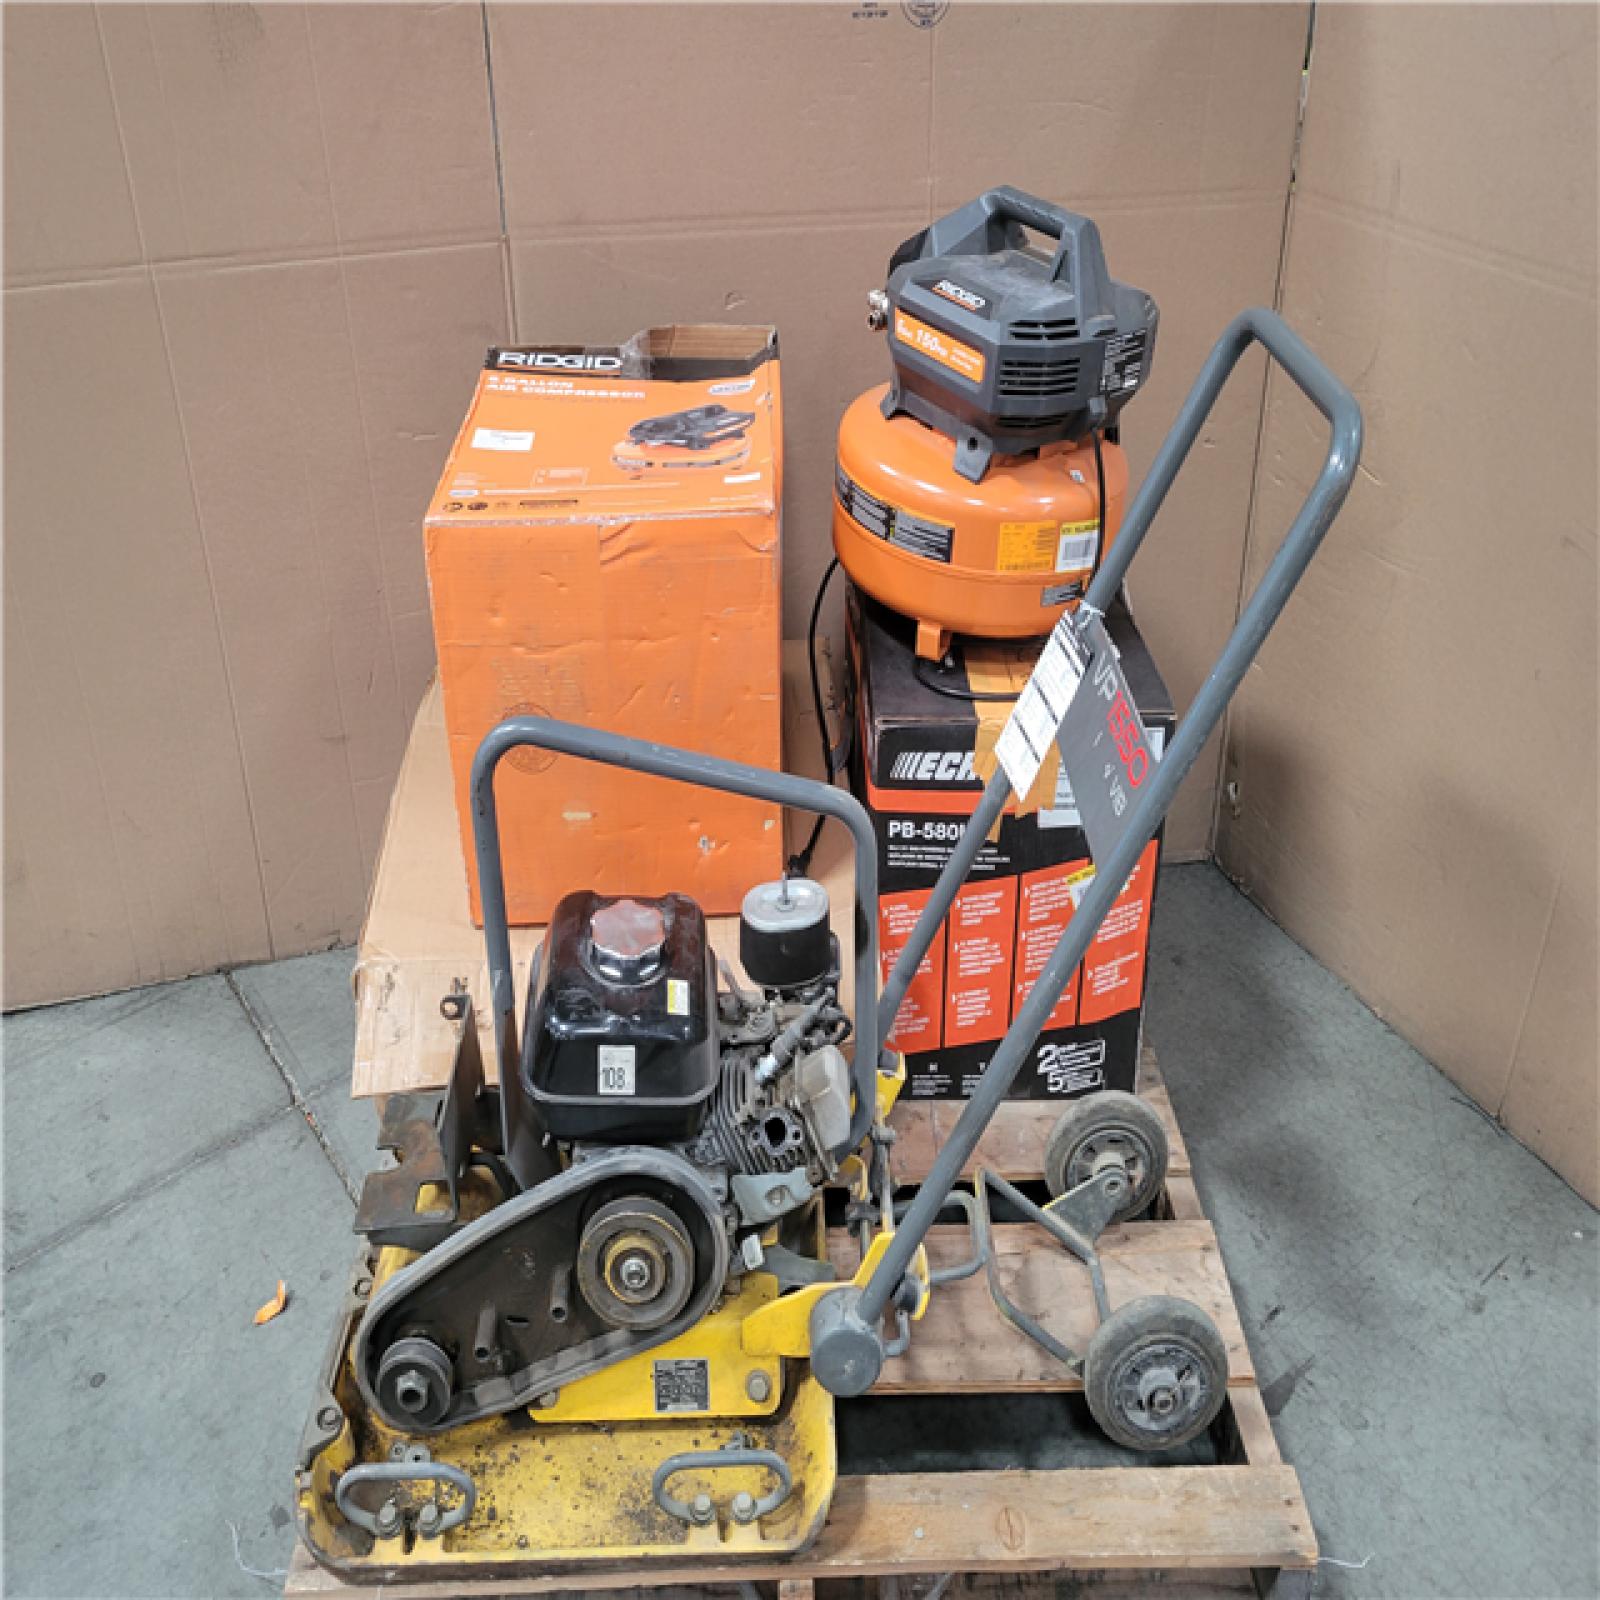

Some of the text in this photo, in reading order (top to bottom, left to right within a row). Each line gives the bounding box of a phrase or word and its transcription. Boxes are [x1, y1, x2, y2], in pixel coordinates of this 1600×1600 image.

[914, 327, 940, 353] 150
[499, 351, 622, 370] RIDGID
[522, 386, 646, 400] COMPRESSOR
[914, 751, 977, 781] ECH
[601, 1066, 626, 1090] 108
